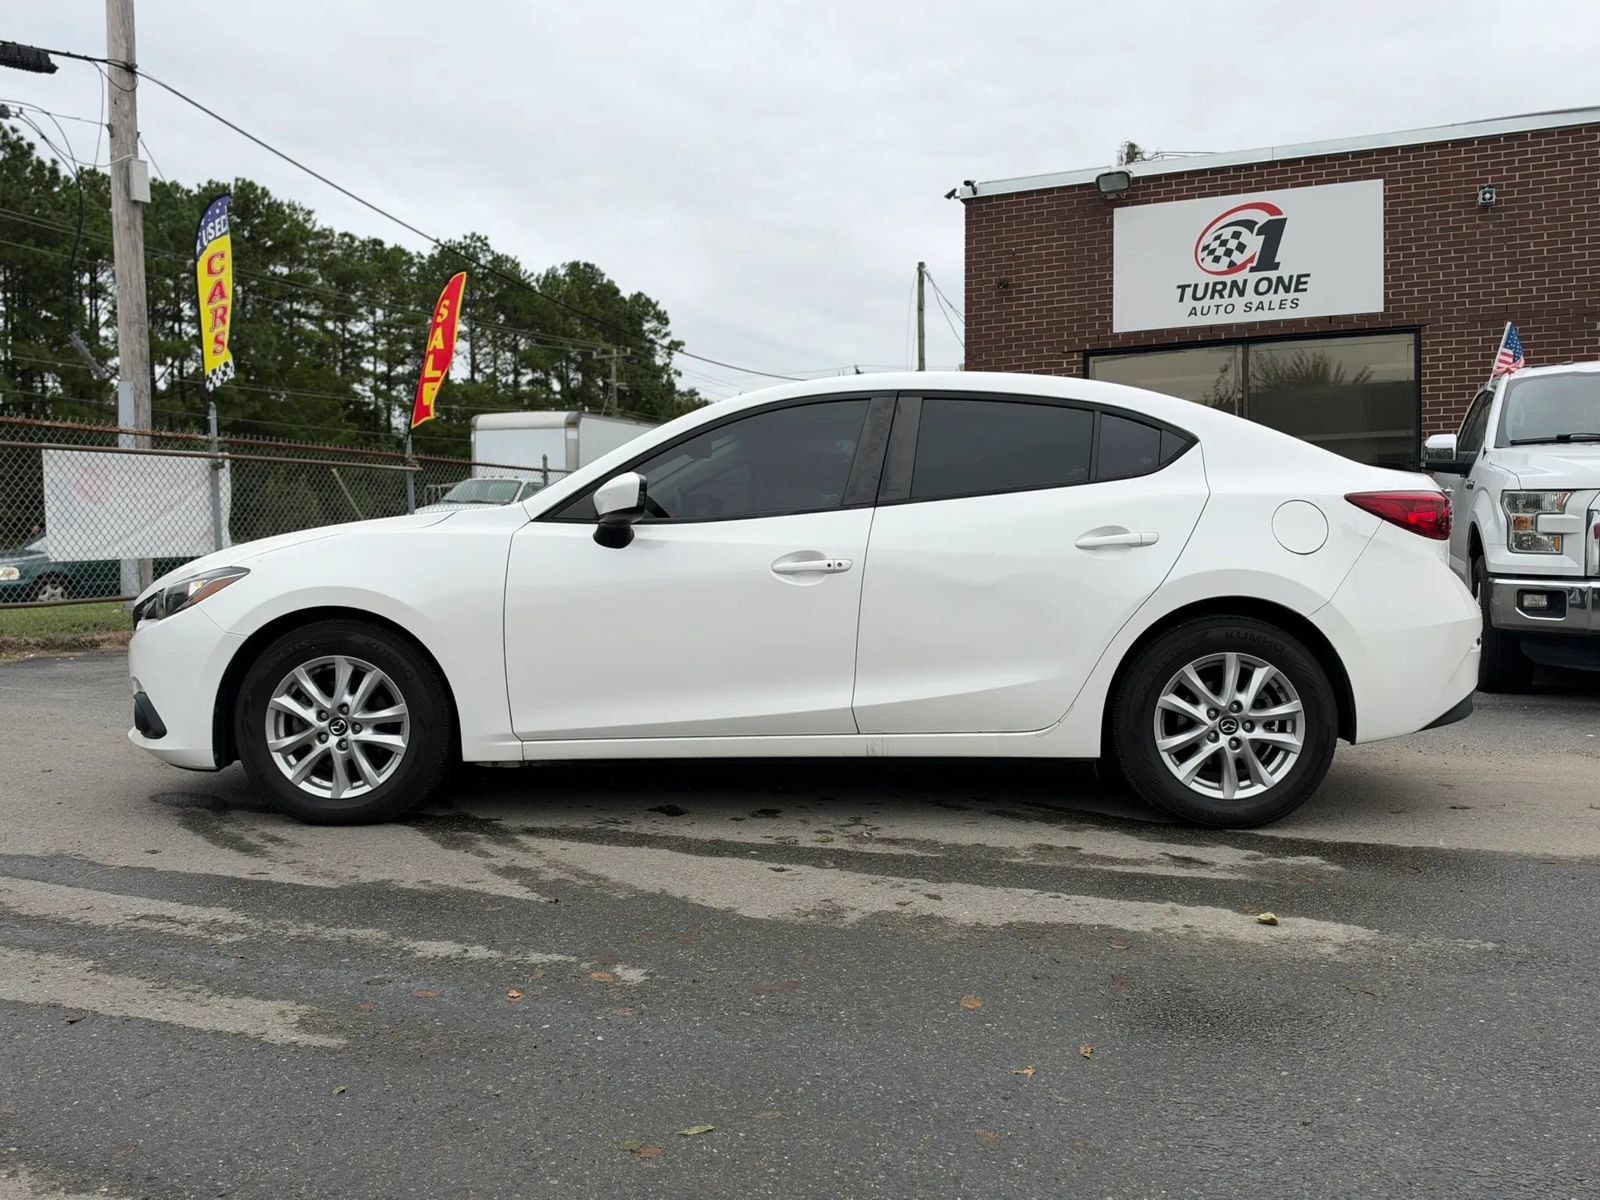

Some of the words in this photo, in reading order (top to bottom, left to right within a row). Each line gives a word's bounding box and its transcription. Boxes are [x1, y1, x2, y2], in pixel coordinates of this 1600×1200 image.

[202, 214, 228, 246] USED
[1176, 278, 1248, 303] TURN
[1253, 273, 1311, 296] ONE
[206, 251, 227, 357] CARS
[1188, 303, 1236, 317] AUTO
[1243, 298, 1300, 313] SALES
[1224, 630, 1285, 651] KUMHO
